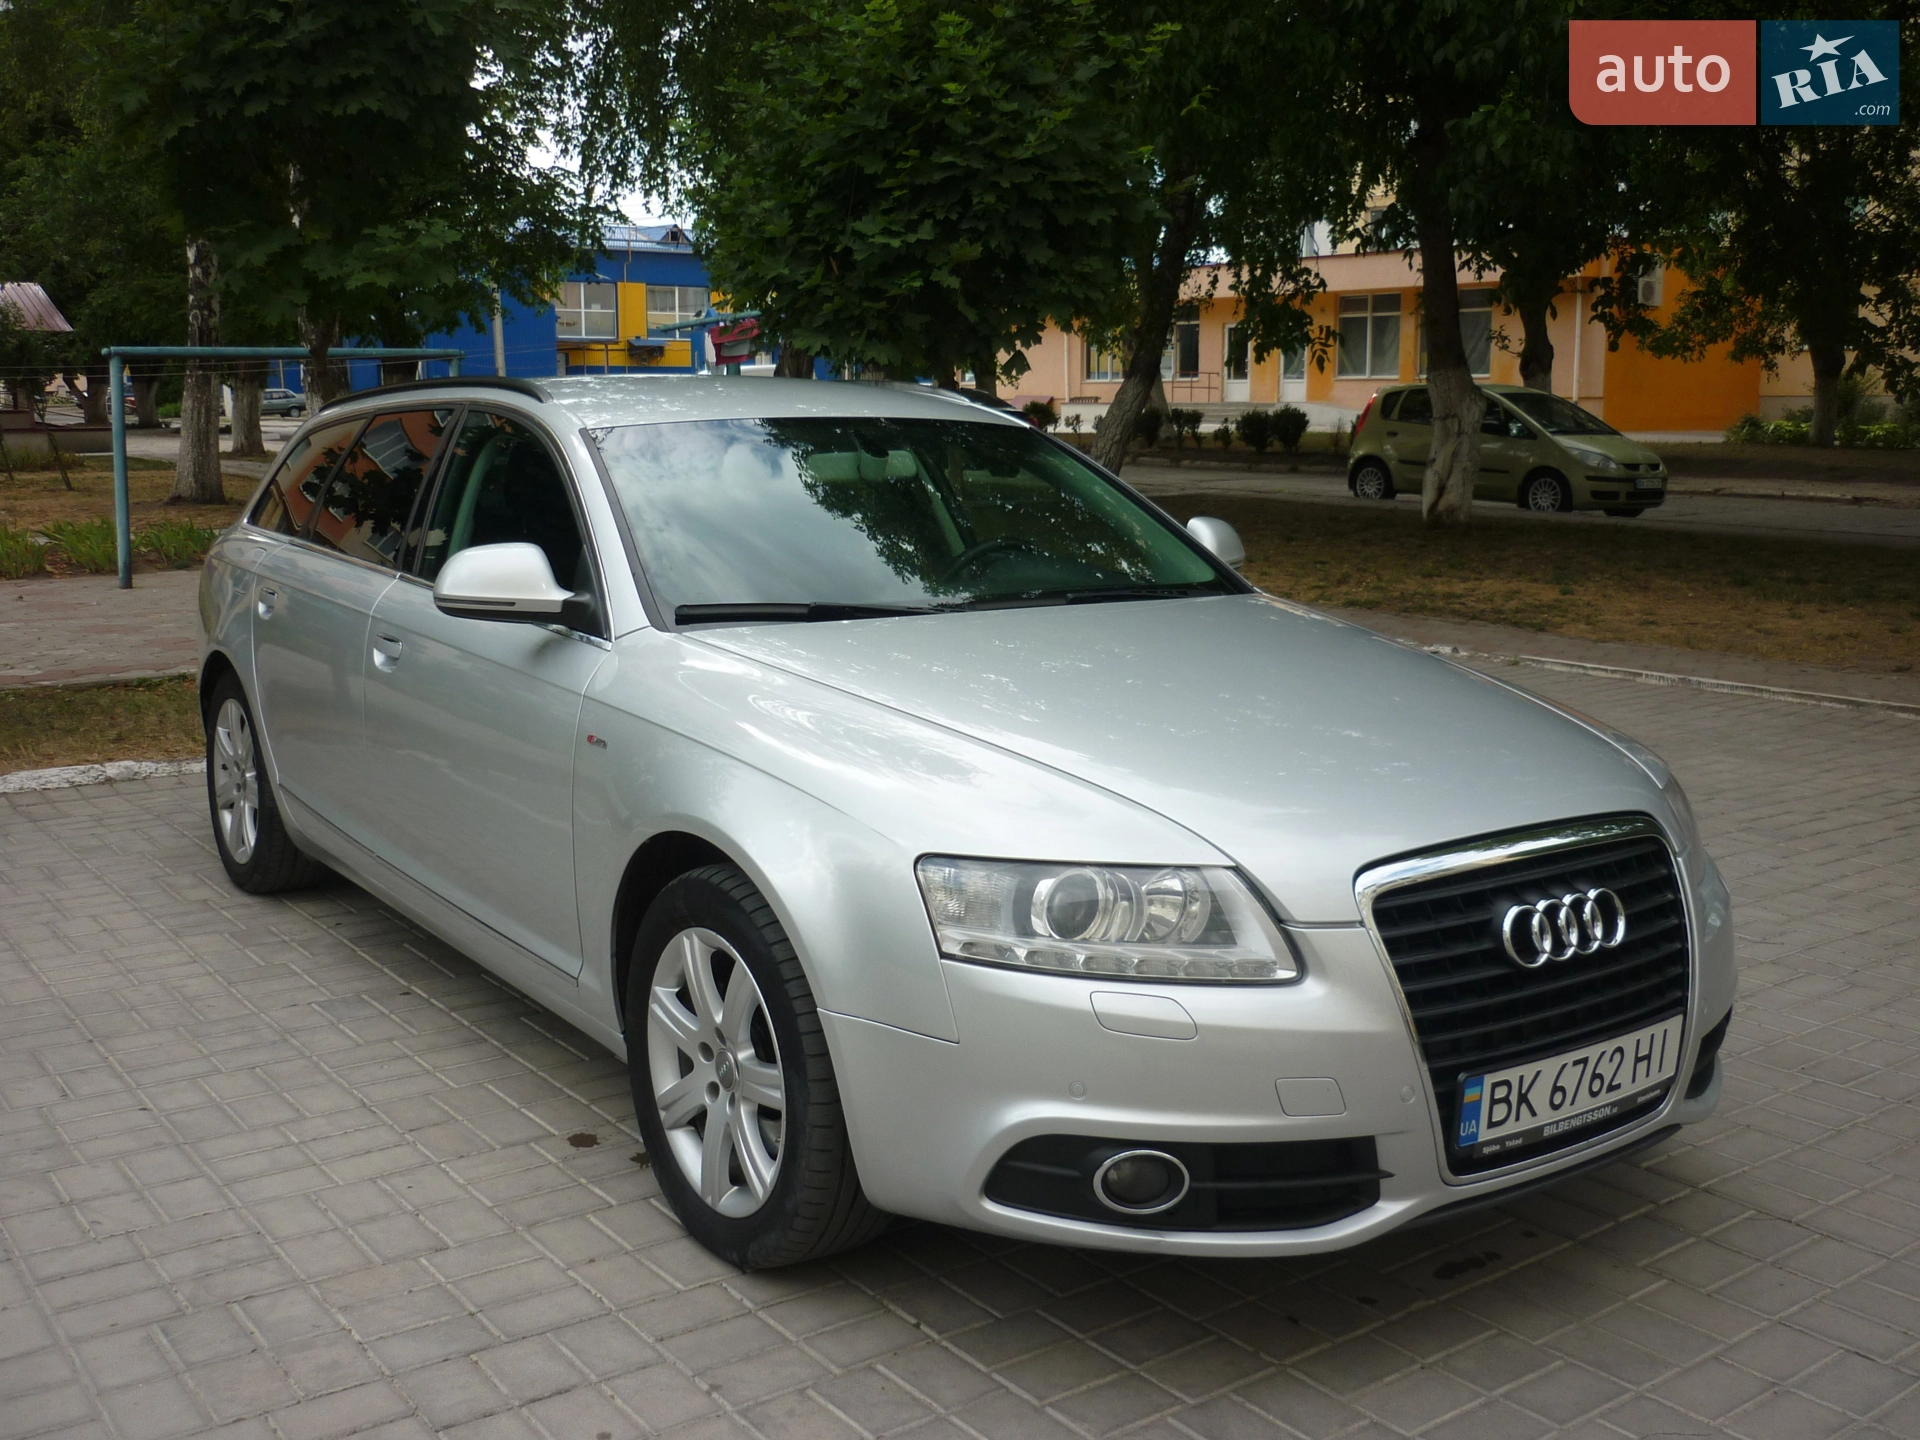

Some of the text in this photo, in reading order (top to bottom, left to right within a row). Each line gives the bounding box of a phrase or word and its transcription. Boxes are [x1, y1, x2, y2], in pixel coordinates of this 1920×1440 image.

[1486, 1028, 1668, 1130] BK 6762 HI
[1460, 1119, 1477, 1136] UA
